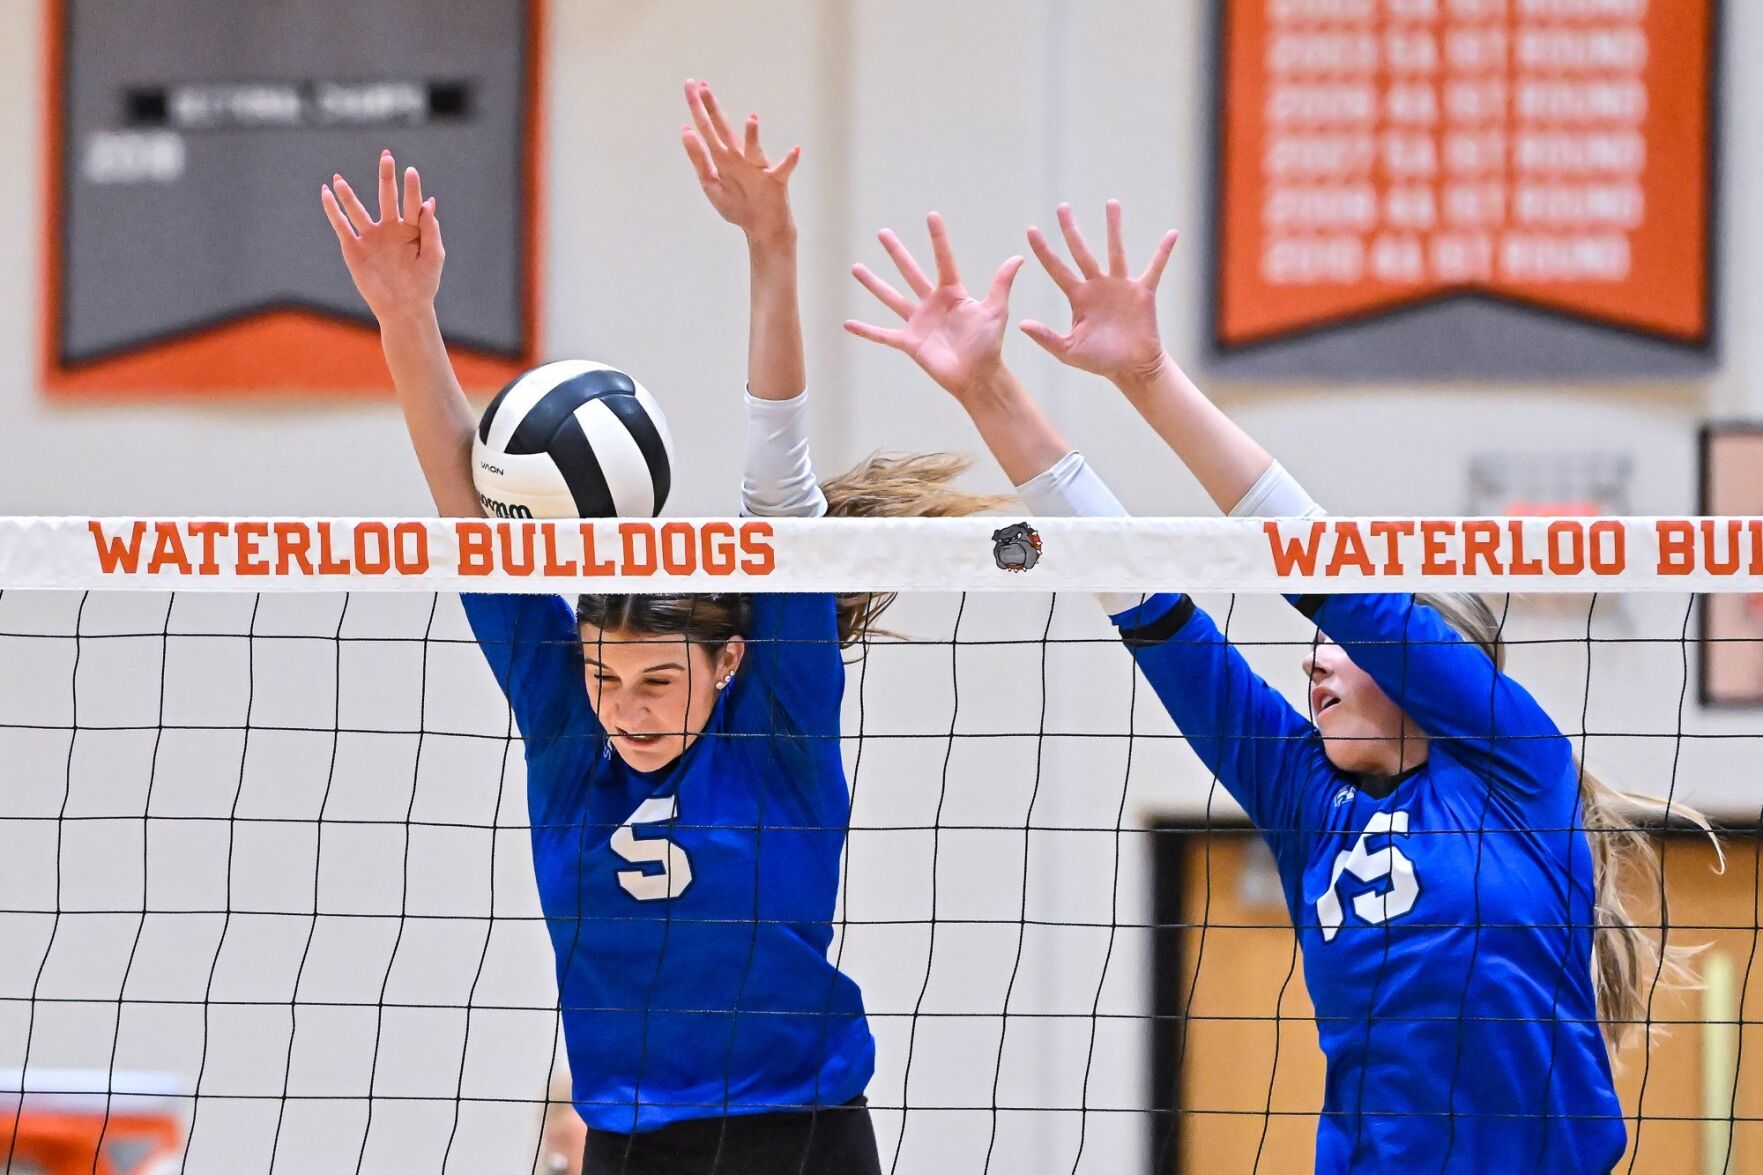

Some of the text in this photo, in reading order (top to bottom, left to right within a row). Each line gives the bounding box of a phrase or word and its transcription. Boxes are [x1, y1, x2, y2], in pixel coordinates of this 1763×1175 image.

[89, 521, 776, 577] WATERLOO BULLDOGS
[1263, 521, 1626, 577] WATERLOO
[610, 794, 693, 901] 5
[1316, 811, 1420, 942] 15
